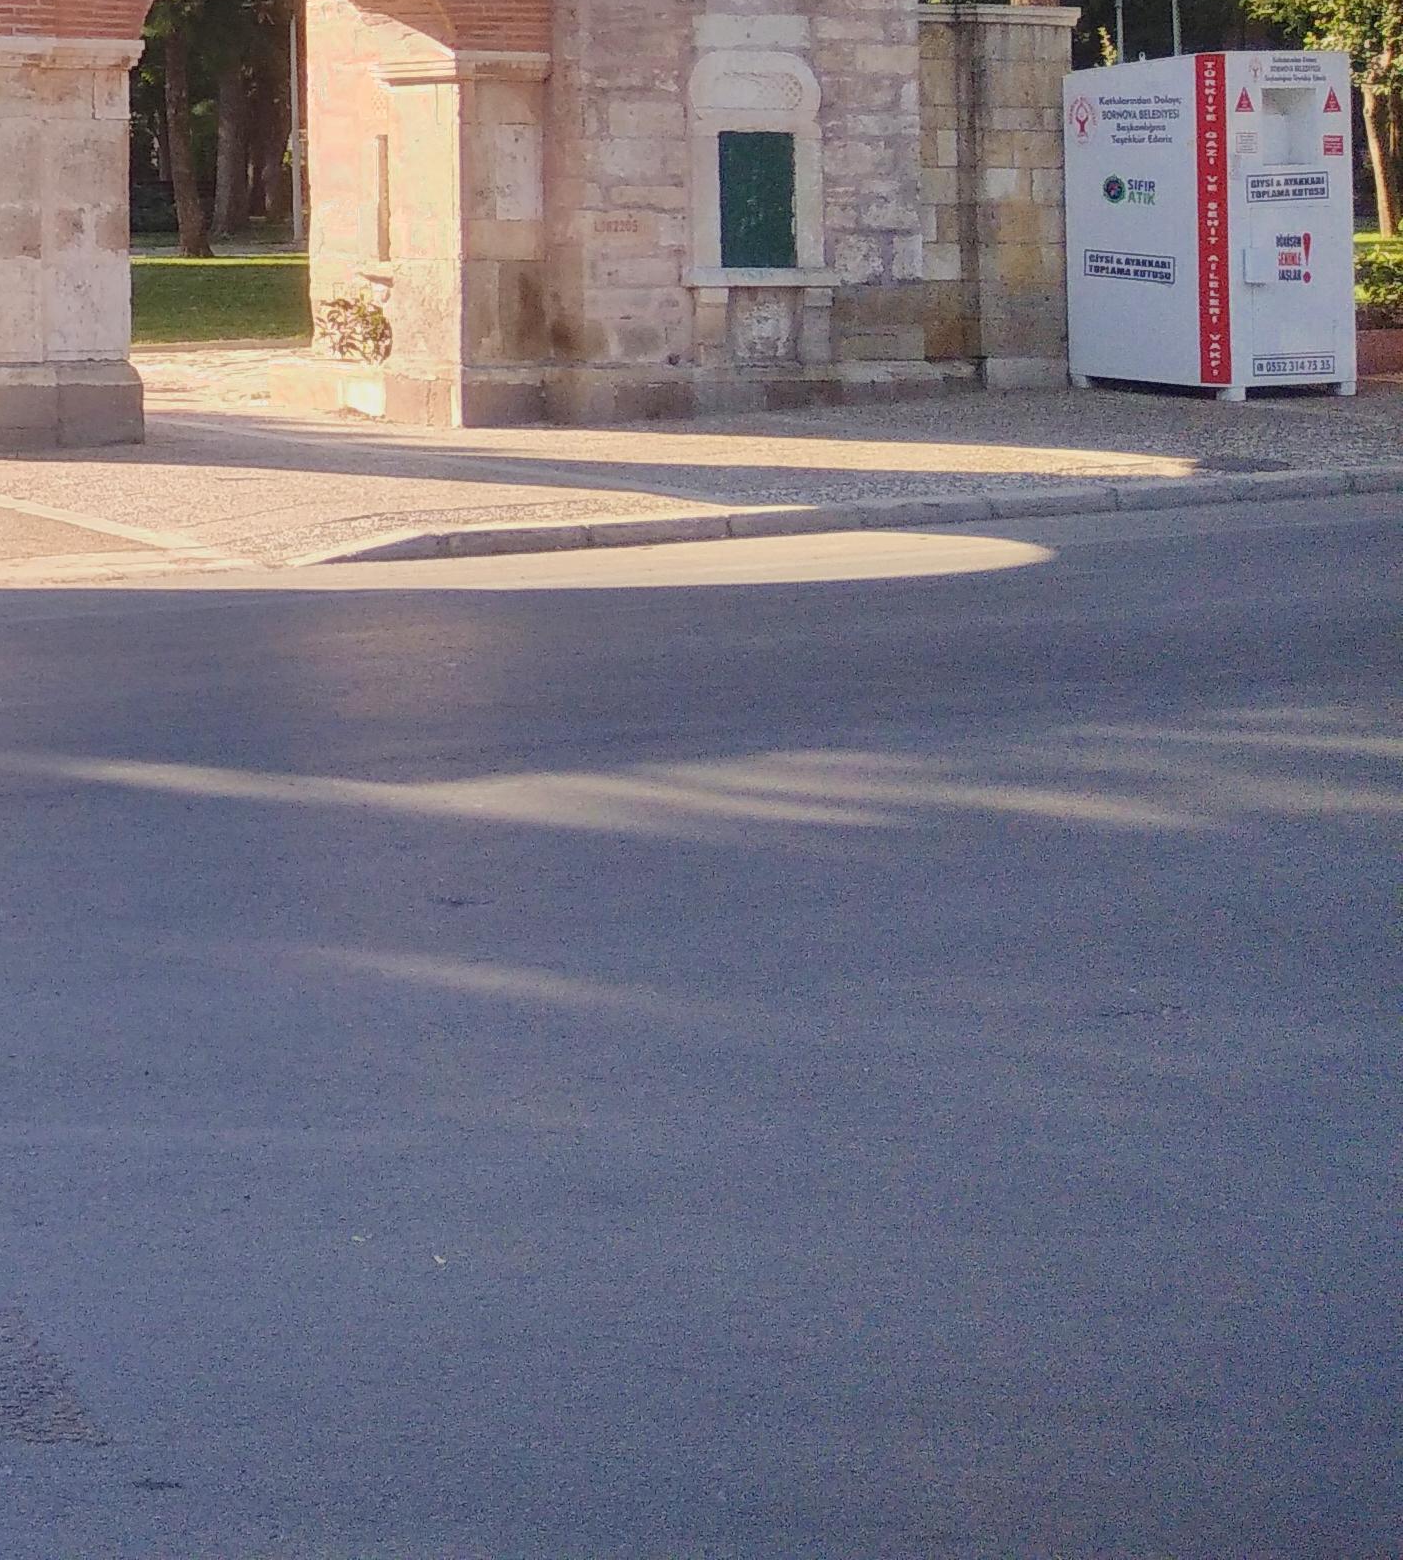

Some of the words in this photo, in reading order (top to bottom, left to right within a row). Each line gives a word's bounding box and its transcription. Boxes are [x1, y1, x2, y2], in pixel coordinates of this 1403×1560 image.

[1101, 110, 1137, 120] BORNOVA
[1127, 179, 1155, 192] SIFIR
[1127, 191, 1156, 205] ATIK
[1088, 264, 1131, 276] TOPLAMA
[1288, 361, 1305, 371] 314
